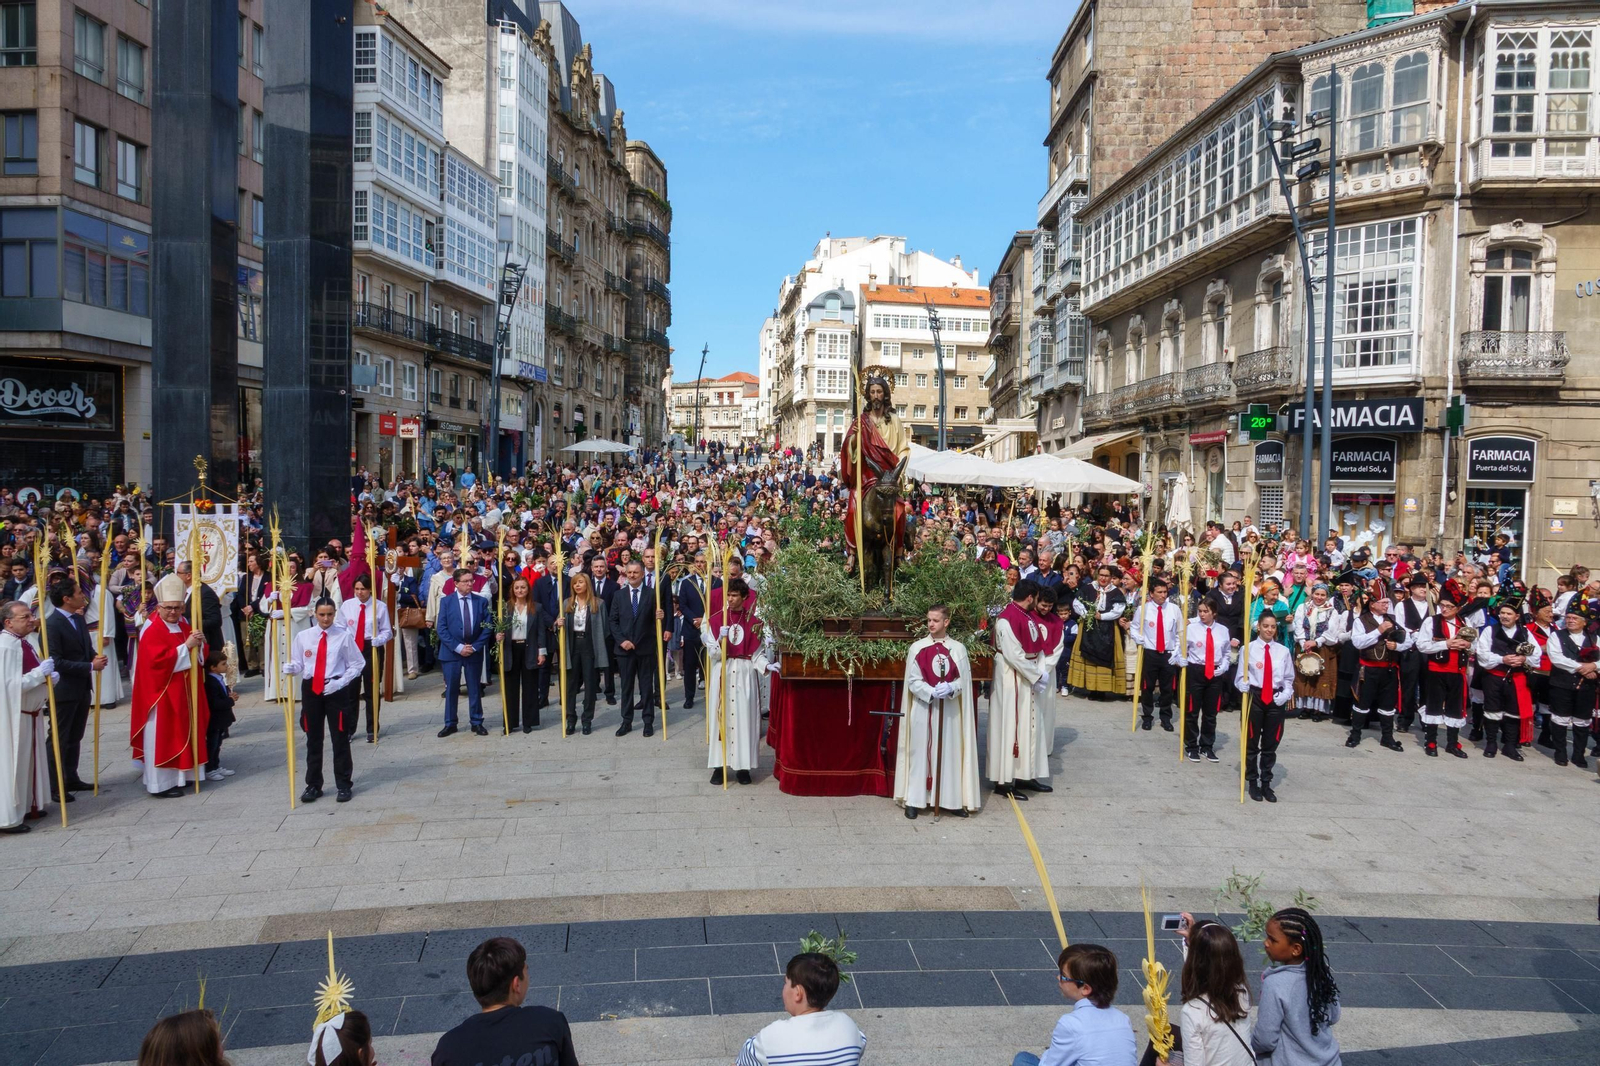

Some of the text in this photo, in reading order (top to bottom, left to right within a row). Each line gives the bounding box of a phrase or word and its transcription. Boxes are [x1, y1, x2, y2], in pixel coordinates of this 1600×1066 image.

[0, 378, 97, 418] Dooers
[1294, 405, 1416, 428] FARMACIA
[1256, 454, 1282, 463] FARMACIA
[1332, 451, 1392, 462] FARMACIA
[1472, 449, 1531, 461] FARMACIA
[1369, 465, 1382, 473] Sol,
[1475, 464, 1497, 472] Puerta
[1509, 465, 1521, 473] Sol,
